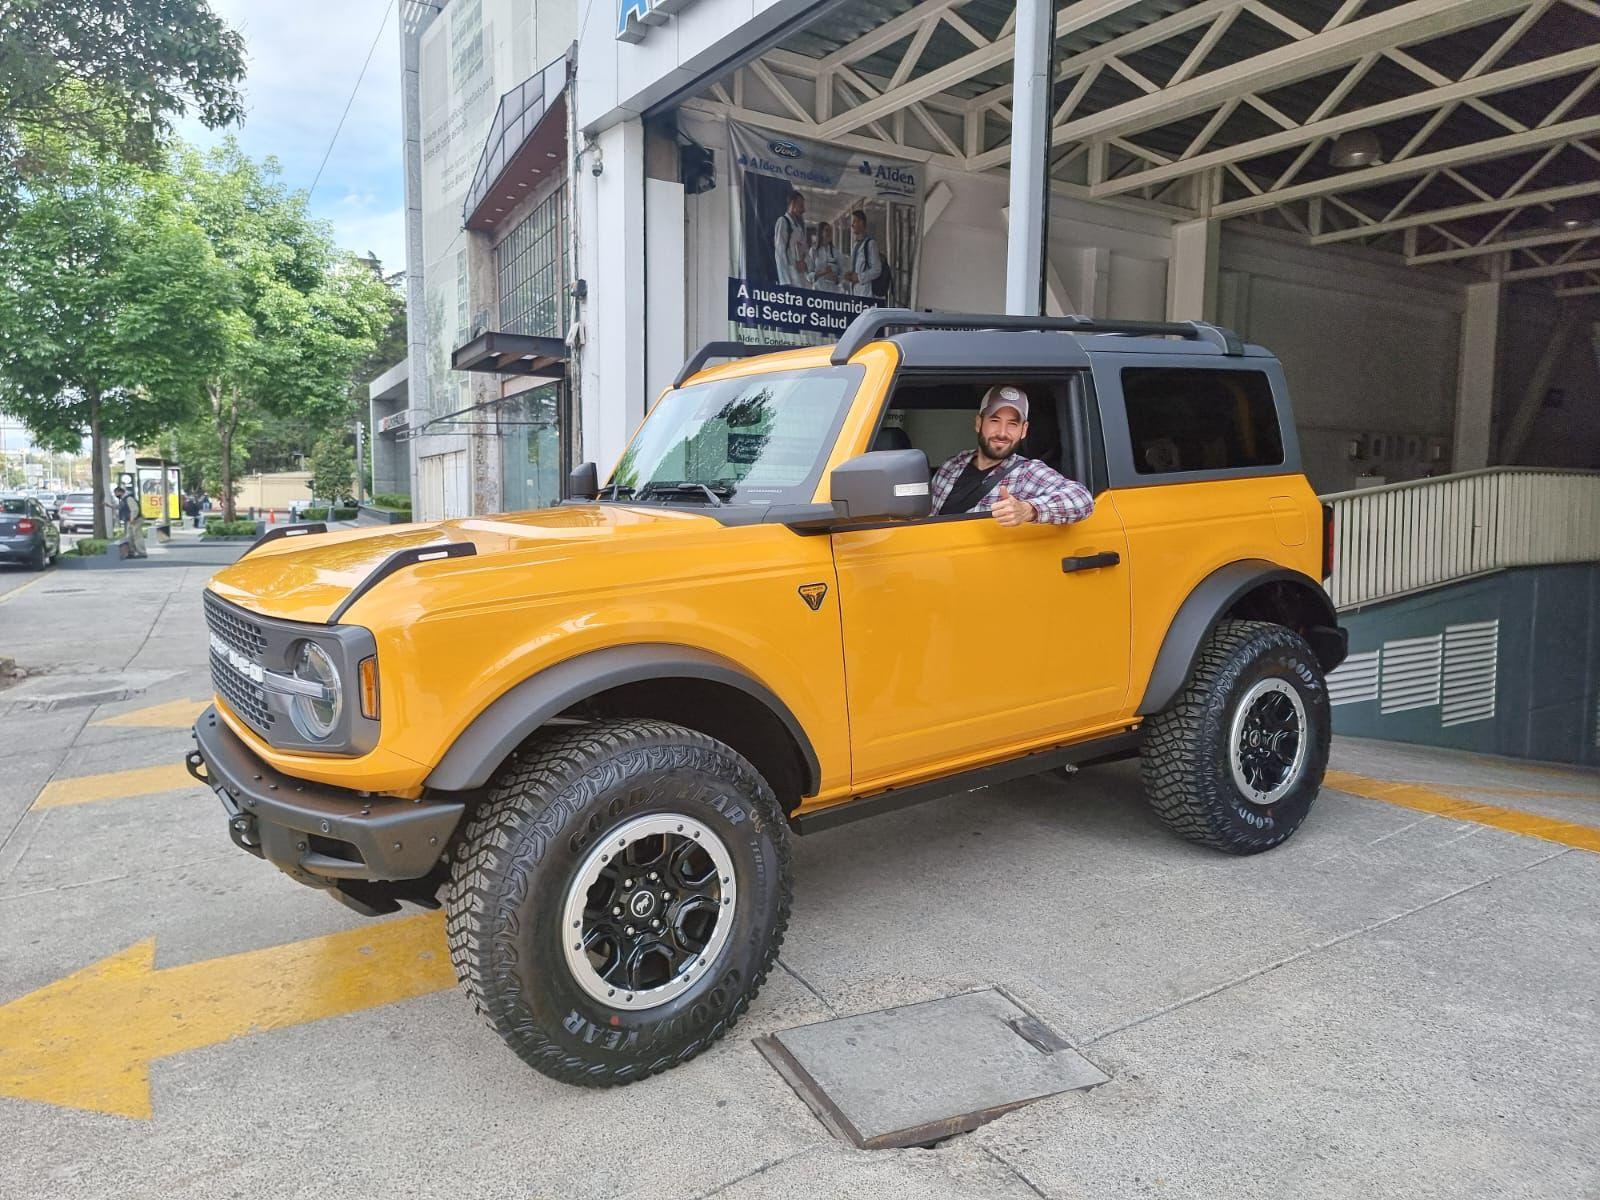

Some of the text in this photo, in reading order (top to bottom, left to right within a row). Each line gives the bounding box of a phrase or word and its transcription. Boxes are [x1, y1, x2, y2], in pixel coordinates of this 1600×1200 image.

[749, 157, 783, 173] Alden
[875, 164, 915, 185] Alden
[737, 284, 749, 299] A
[752, 289, 803, 307] nuestra
[737, 303, 847, 330] del Sector Salud
